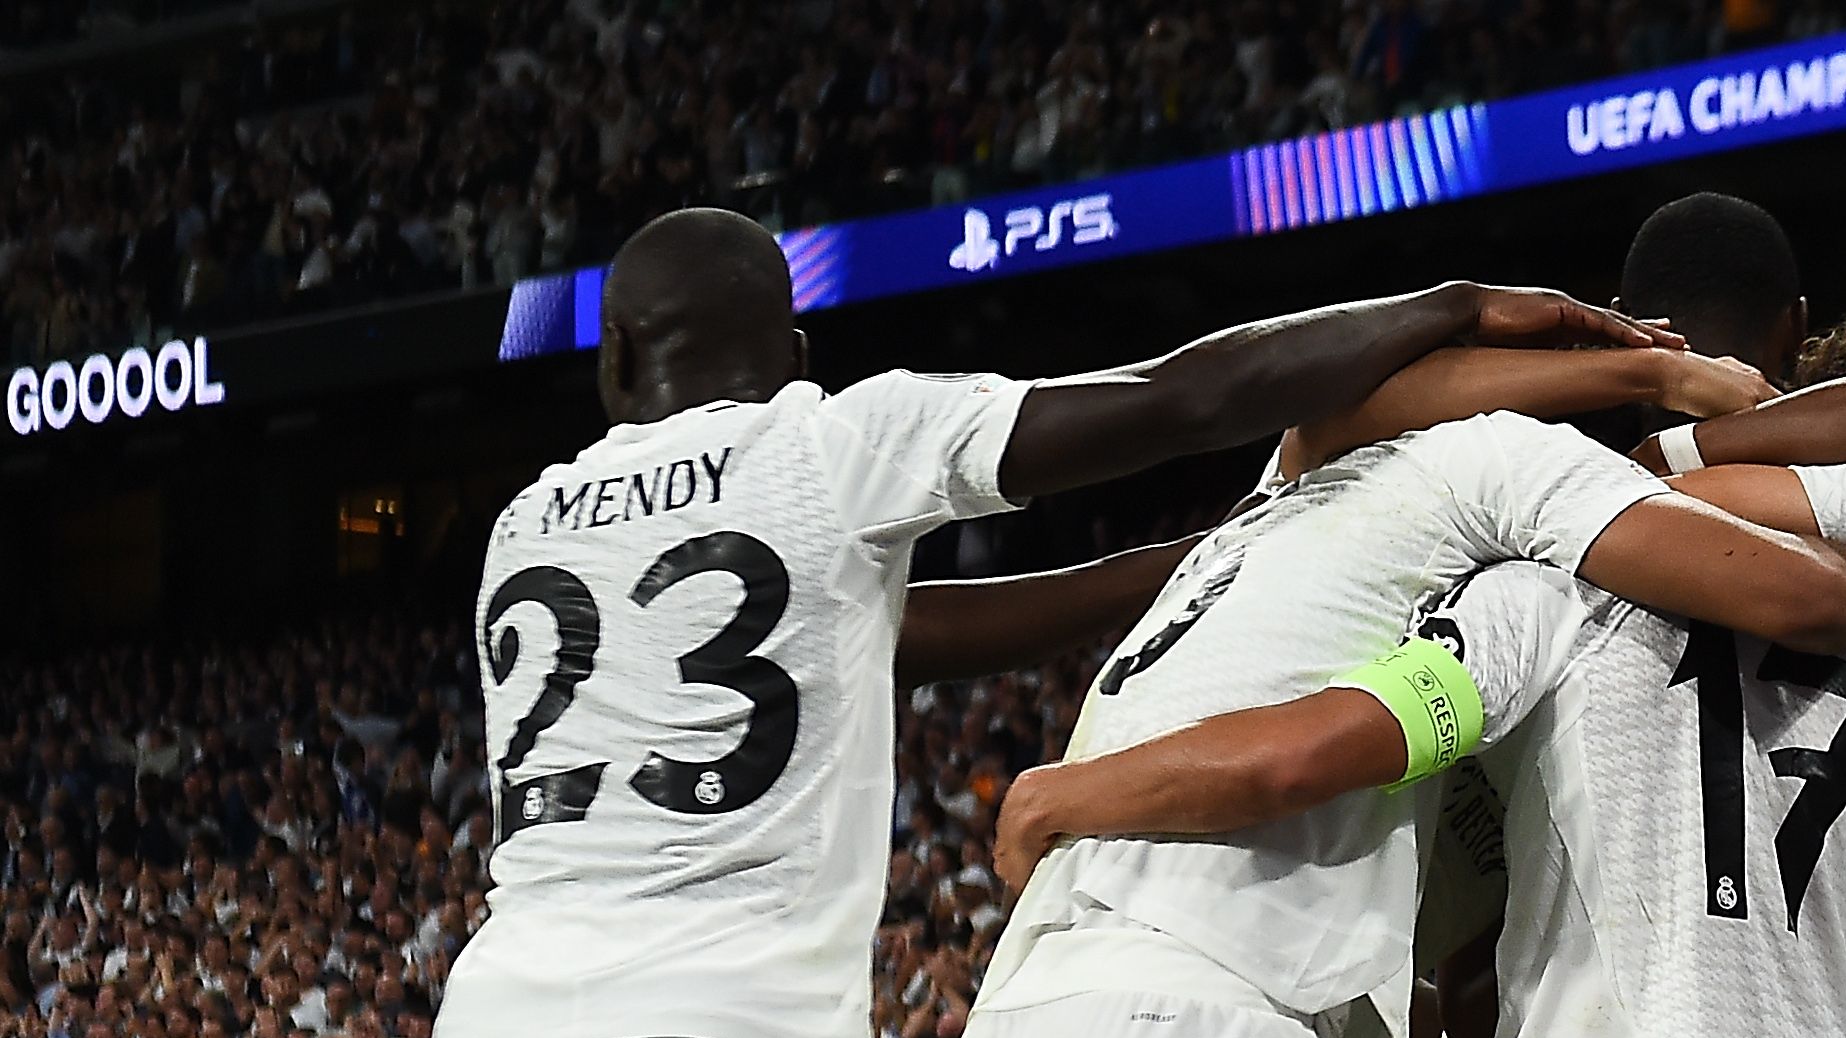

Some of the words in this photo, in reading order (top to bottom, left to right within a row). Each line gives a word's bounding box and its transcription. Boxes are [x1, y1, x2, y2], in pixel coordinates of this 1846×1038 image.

[1567, 88, 1685, 155] UEFA
[1005, 193, 1116, 256] PS5
[7, 336, 225, 435] GOOOOL
[541, 447, 734, 535] MENDY
[486, 530, 798, 847] 23
